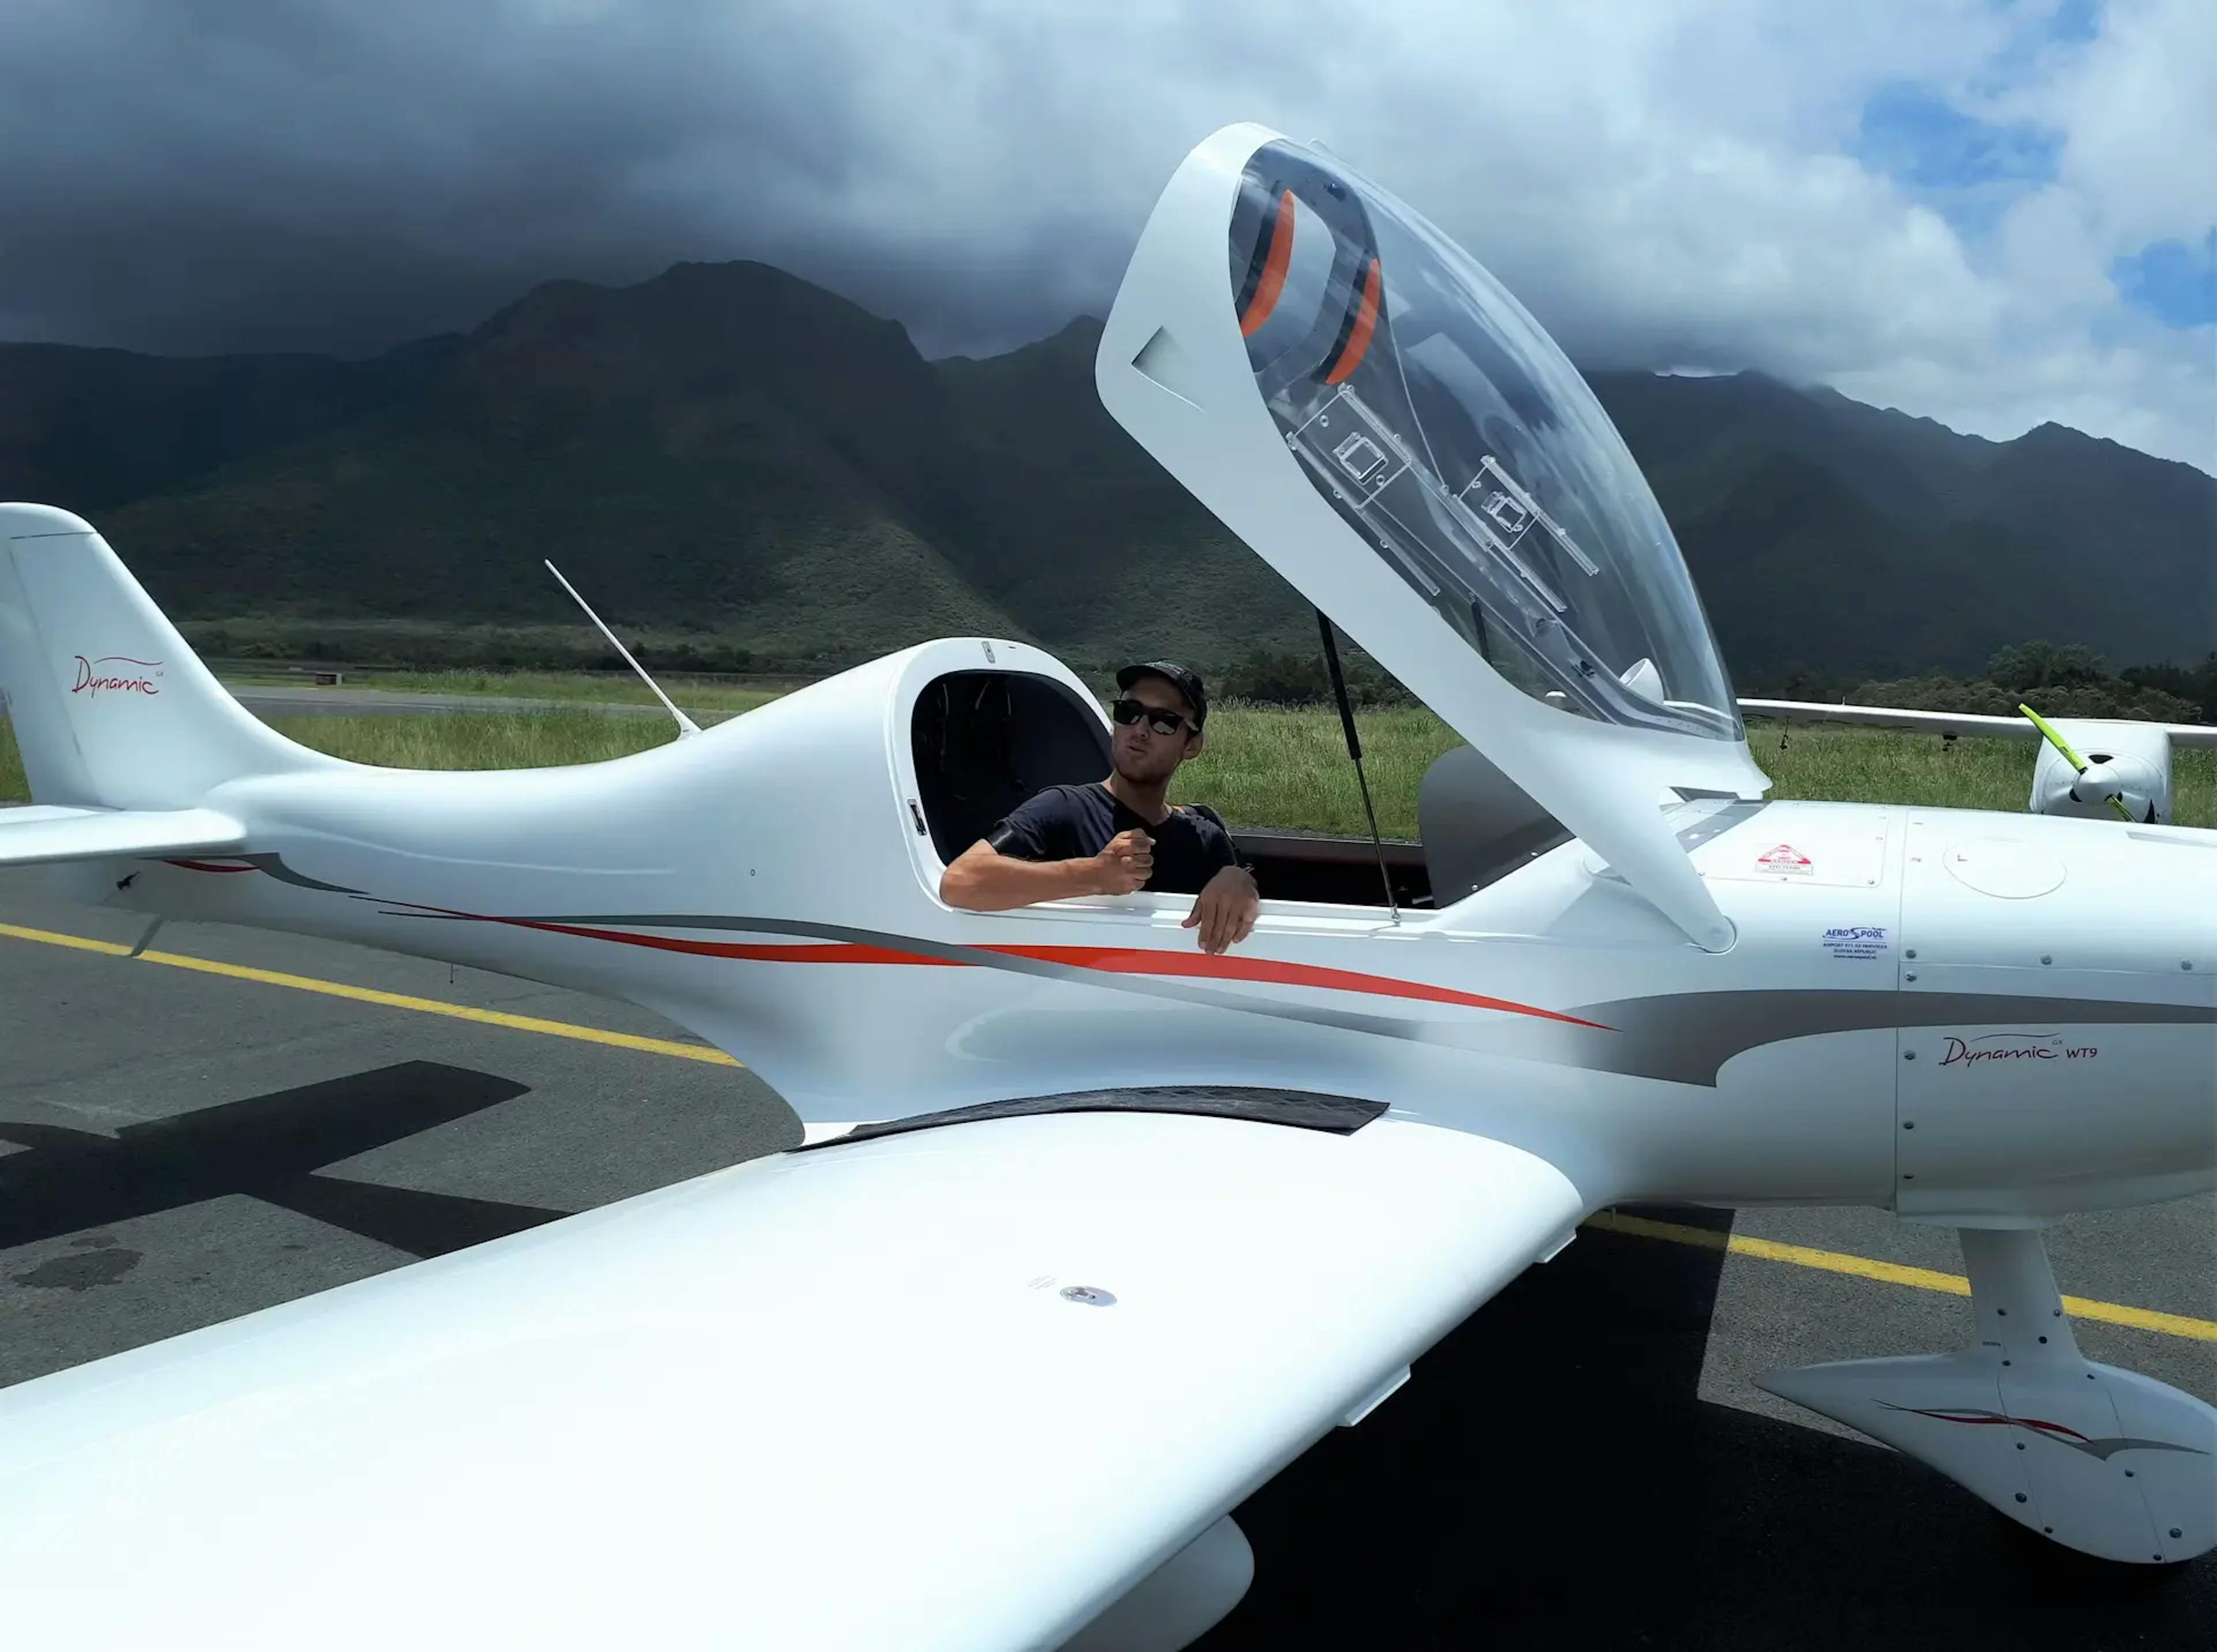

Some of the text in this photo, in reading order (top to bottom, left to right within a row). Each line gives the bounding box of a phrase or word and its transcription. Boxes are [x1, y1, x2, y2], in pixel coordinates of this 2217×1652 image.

[72, 655, 159, 698] Dynamic
[1939, 1037, 2059, 1067] Dynamic
[2066, 1047, 2097, 1059] WT9
